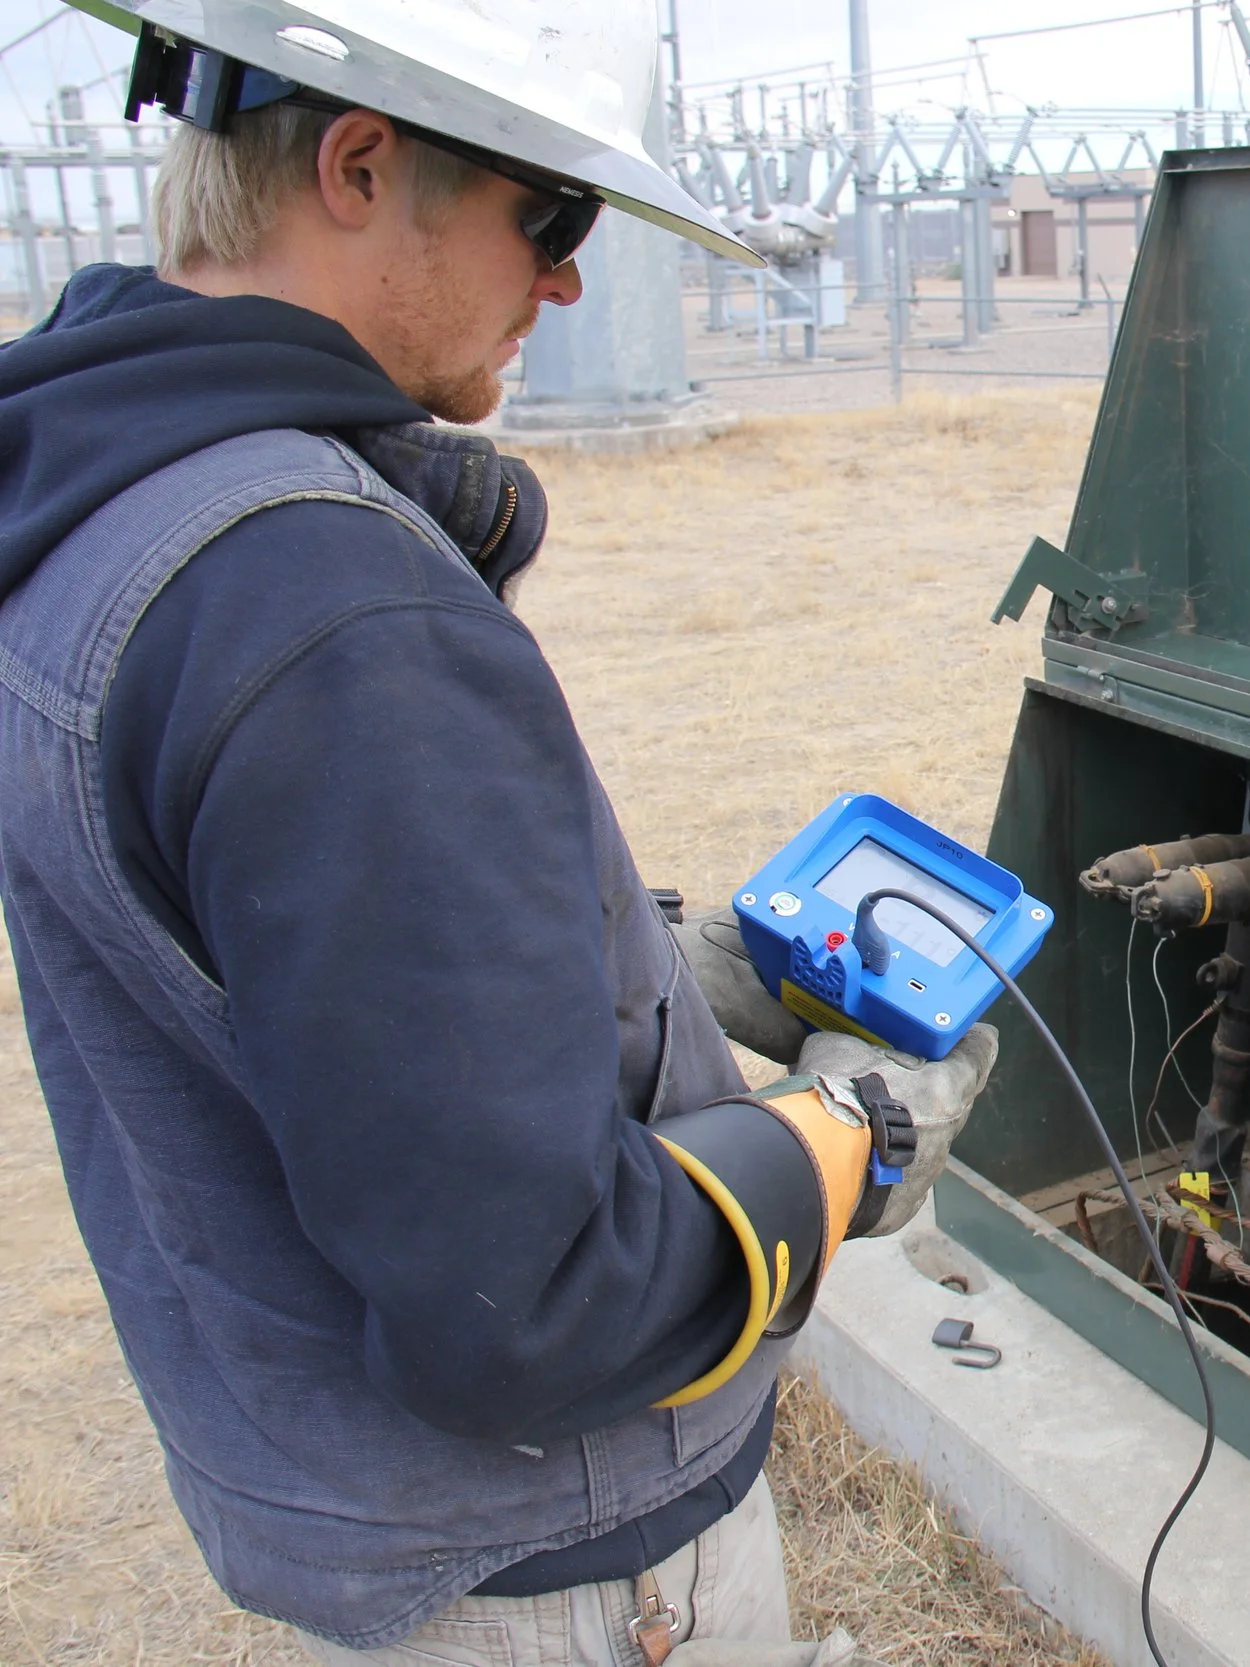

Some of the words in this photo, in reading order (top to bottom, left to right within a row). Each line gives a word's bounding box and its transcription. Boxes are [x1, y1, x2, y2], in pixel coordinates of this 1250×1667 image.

[560, 186, 584, 198] NEMESIS
[937, 841, 964, 860] JP10
[891, 950, 900, 959] A
